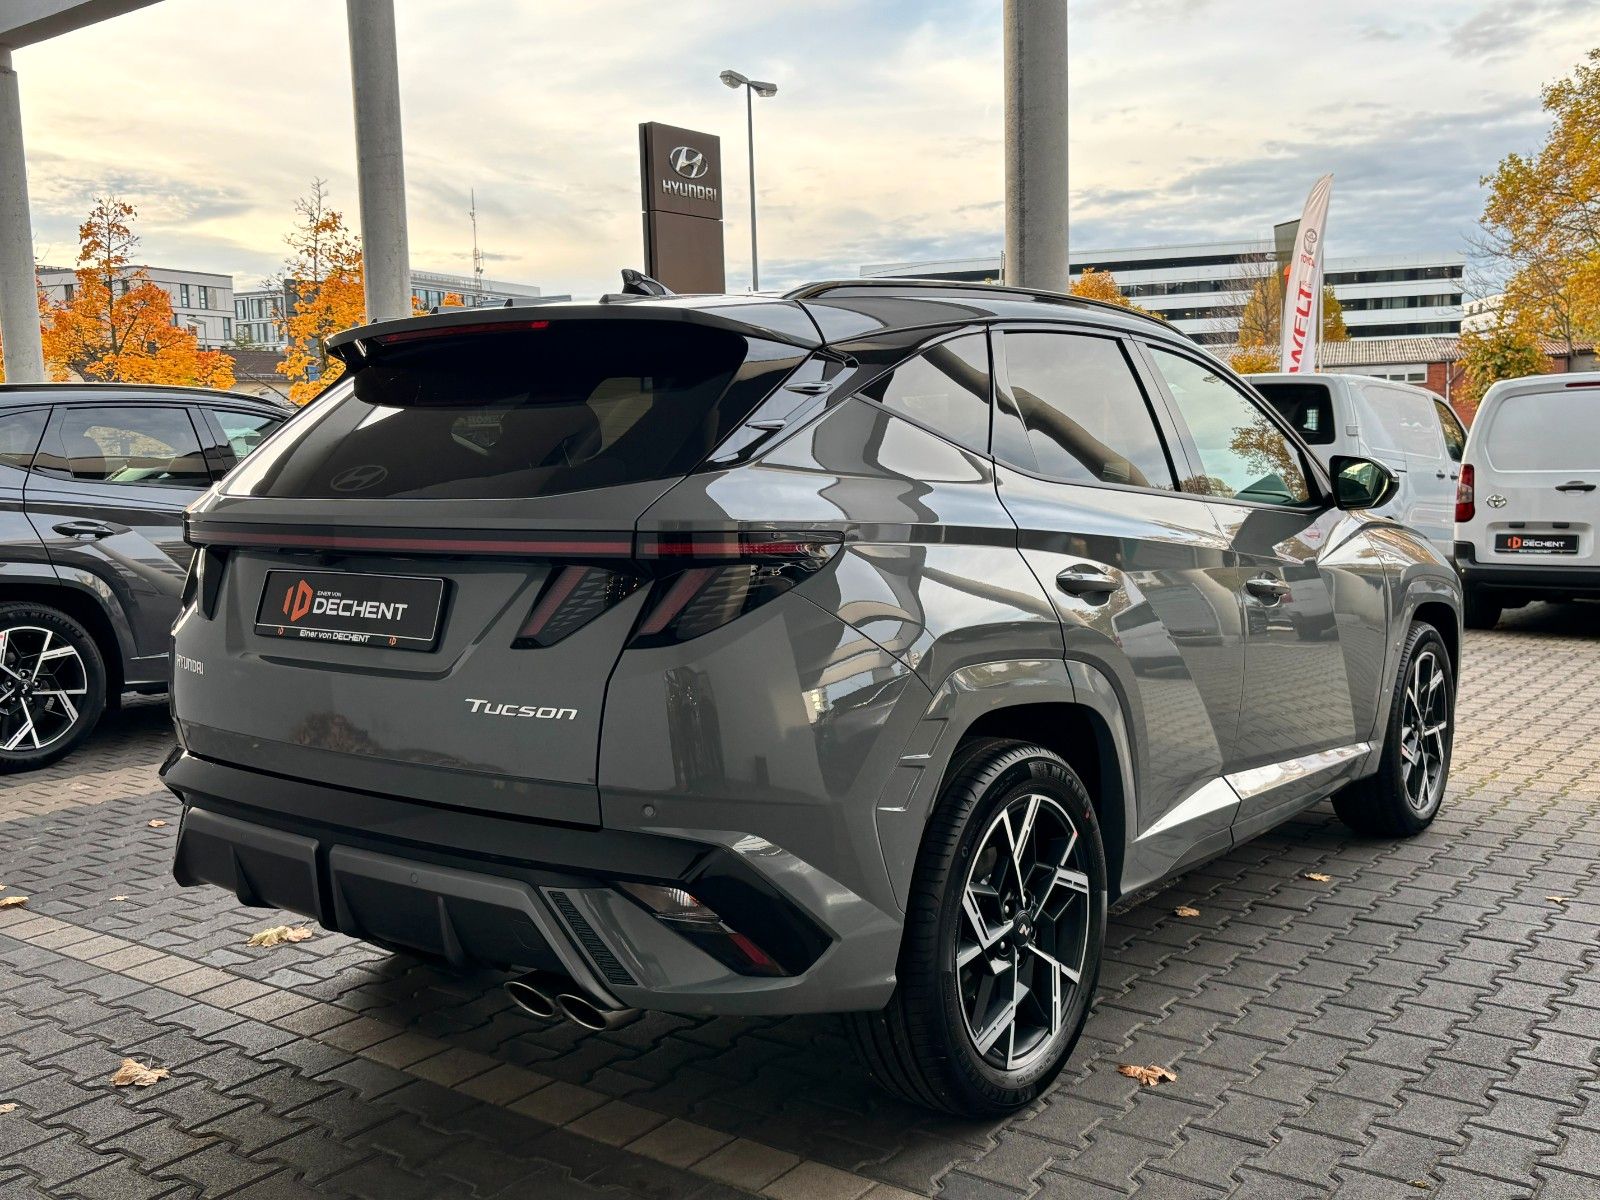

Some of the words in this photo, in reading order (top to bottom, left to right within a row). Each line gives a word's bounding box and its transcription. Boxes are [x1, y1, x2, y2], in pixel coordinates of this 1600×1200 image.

[662, 179, 717, 201] HYUNDAI
[1522, 540, 1565, 548] DECHENT
[312, 598, 408, 620] DECHENT
[332, 632, 370, 643] DECHENT
[176, 653, 204, 675] HYUNDAI
